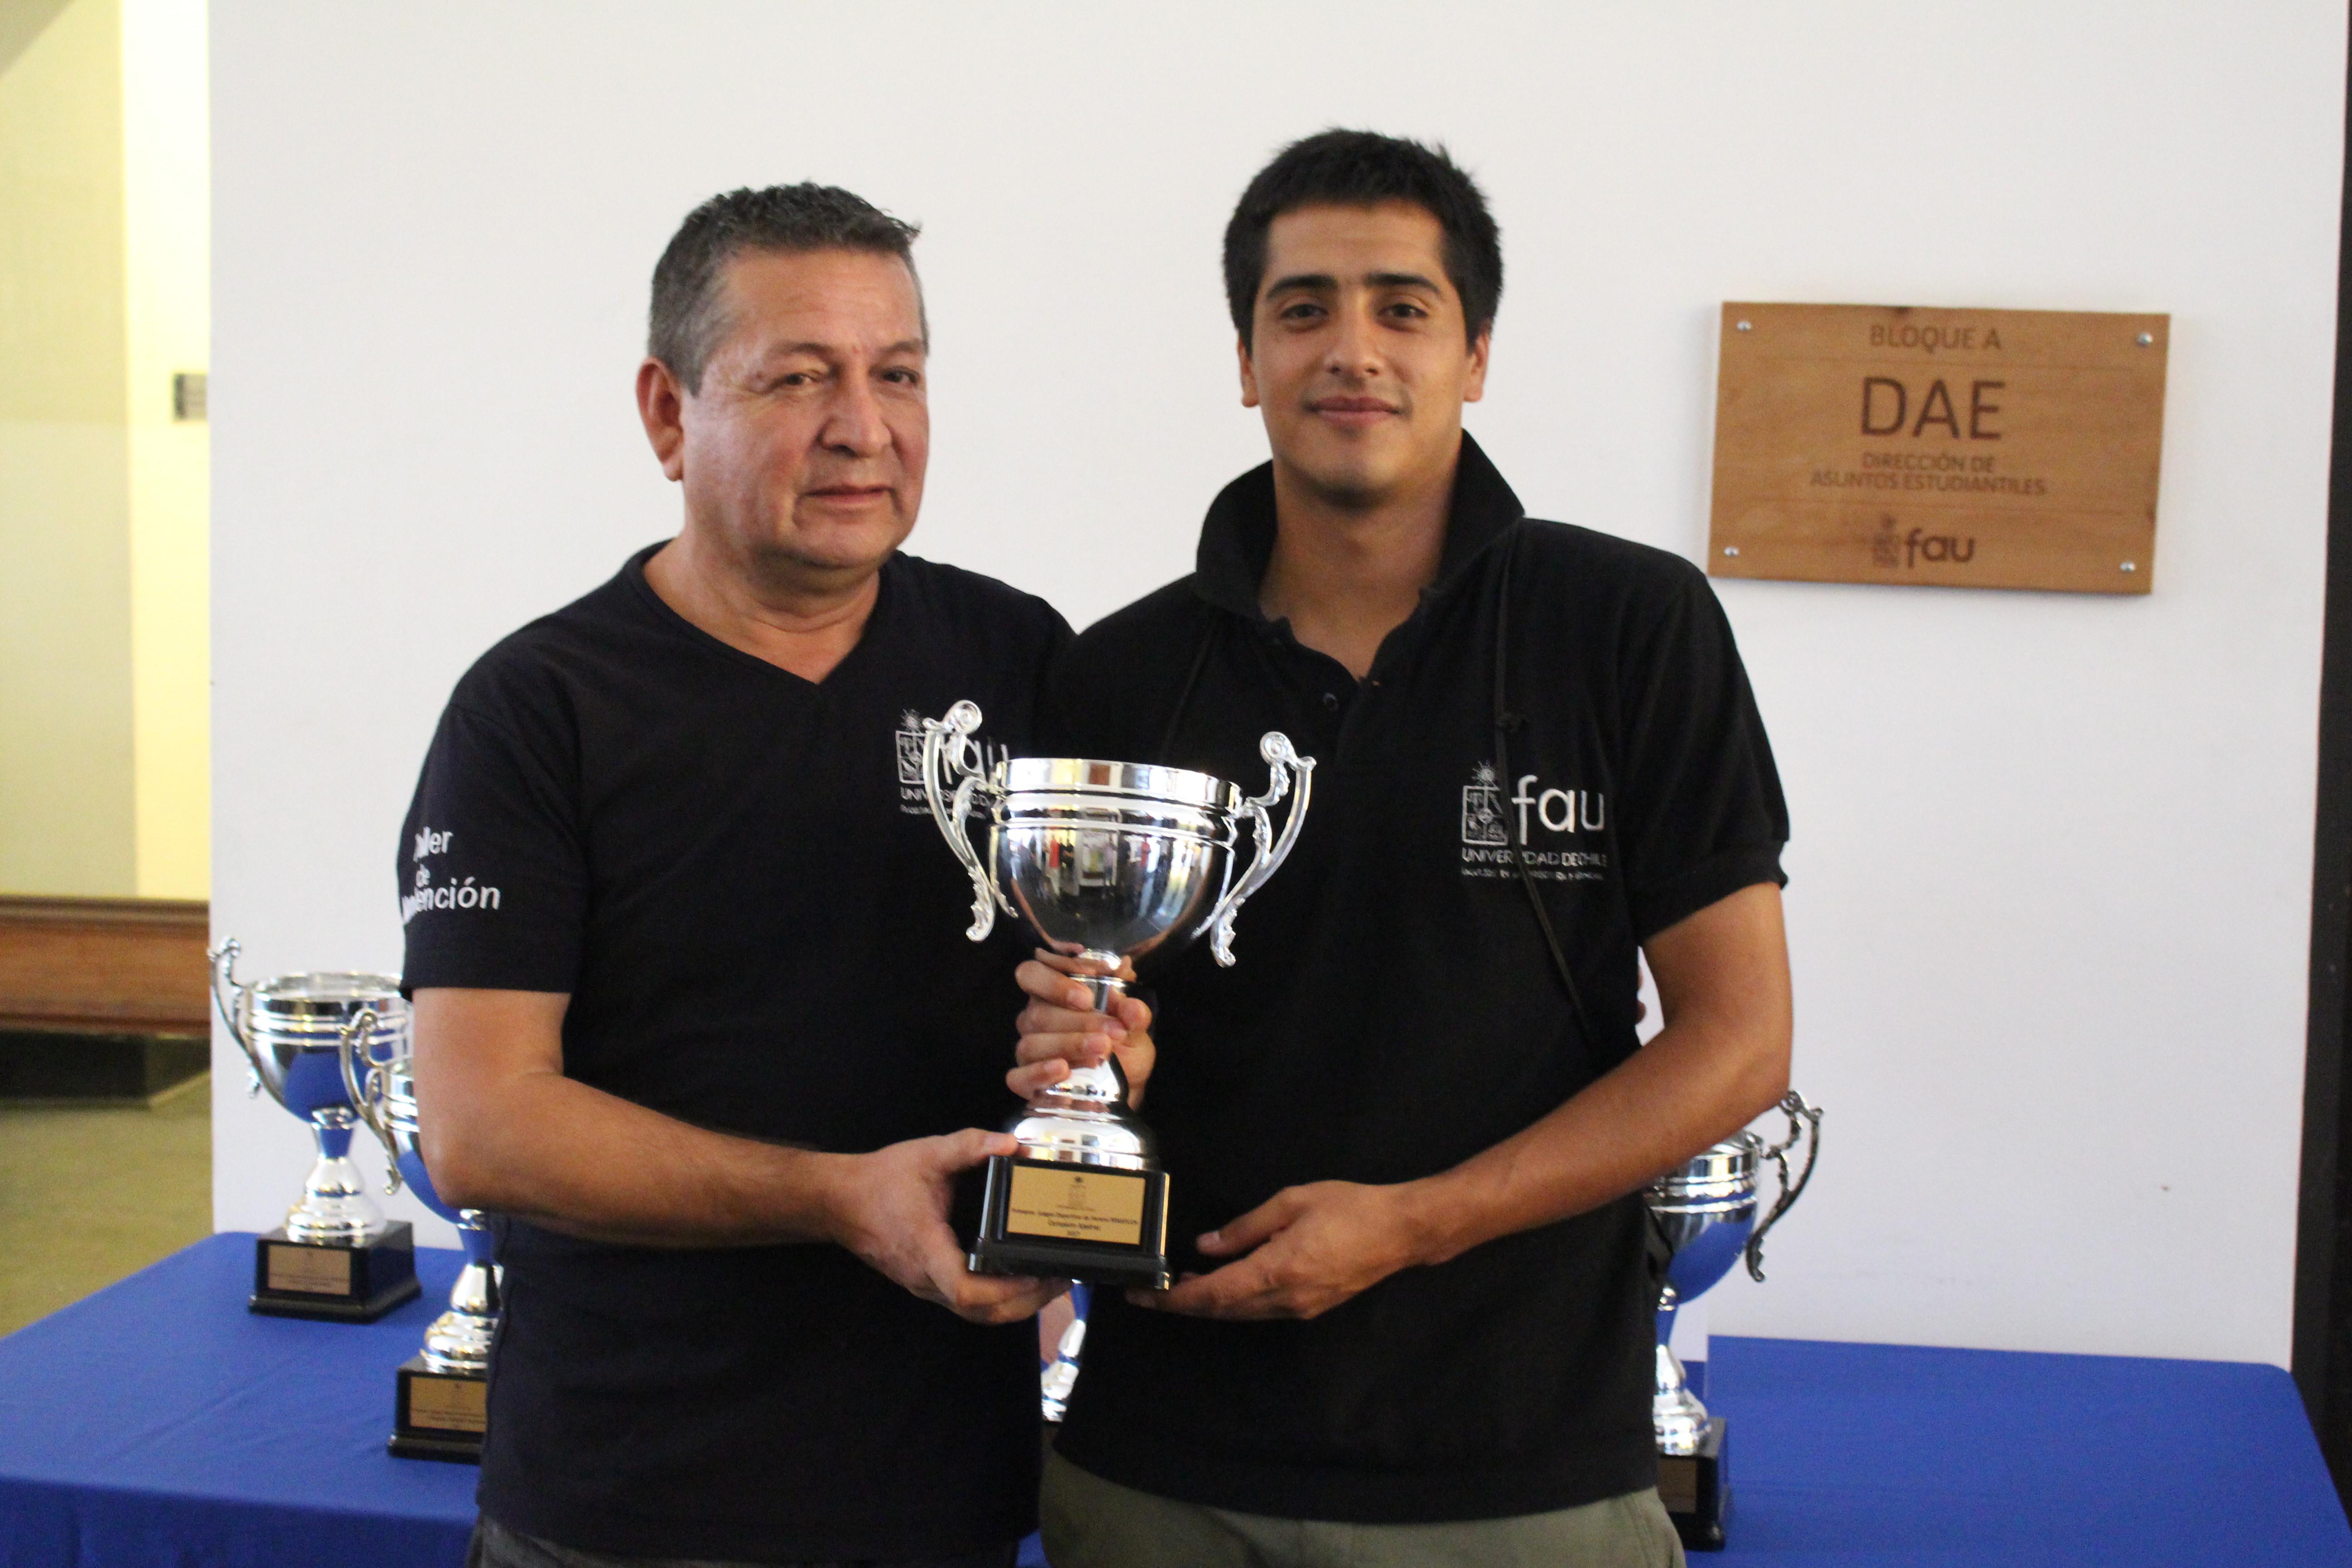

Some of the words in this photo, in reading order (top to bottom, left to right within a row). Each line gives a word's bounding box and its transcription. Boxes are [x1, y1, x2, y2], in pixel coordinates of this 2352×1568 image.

[1870, 324, 1975, 354] BLOQUE
[1985, 328, 2001, 349] A
[1862, 376, 2006, 440] DAE
[1864, 452, 1965, 472] DIRECCIÓN
[1971, 456, 1995, 473] DE
[1811, 470, 1899, 490] ASUNTOS
[1905, 474, 2046, 495] ESTUDIANTILES
[1906, 527, 1975, 569] fau
[1512, 774, 1605, 845] fau
[1561, 852, 1578, 867] DE
